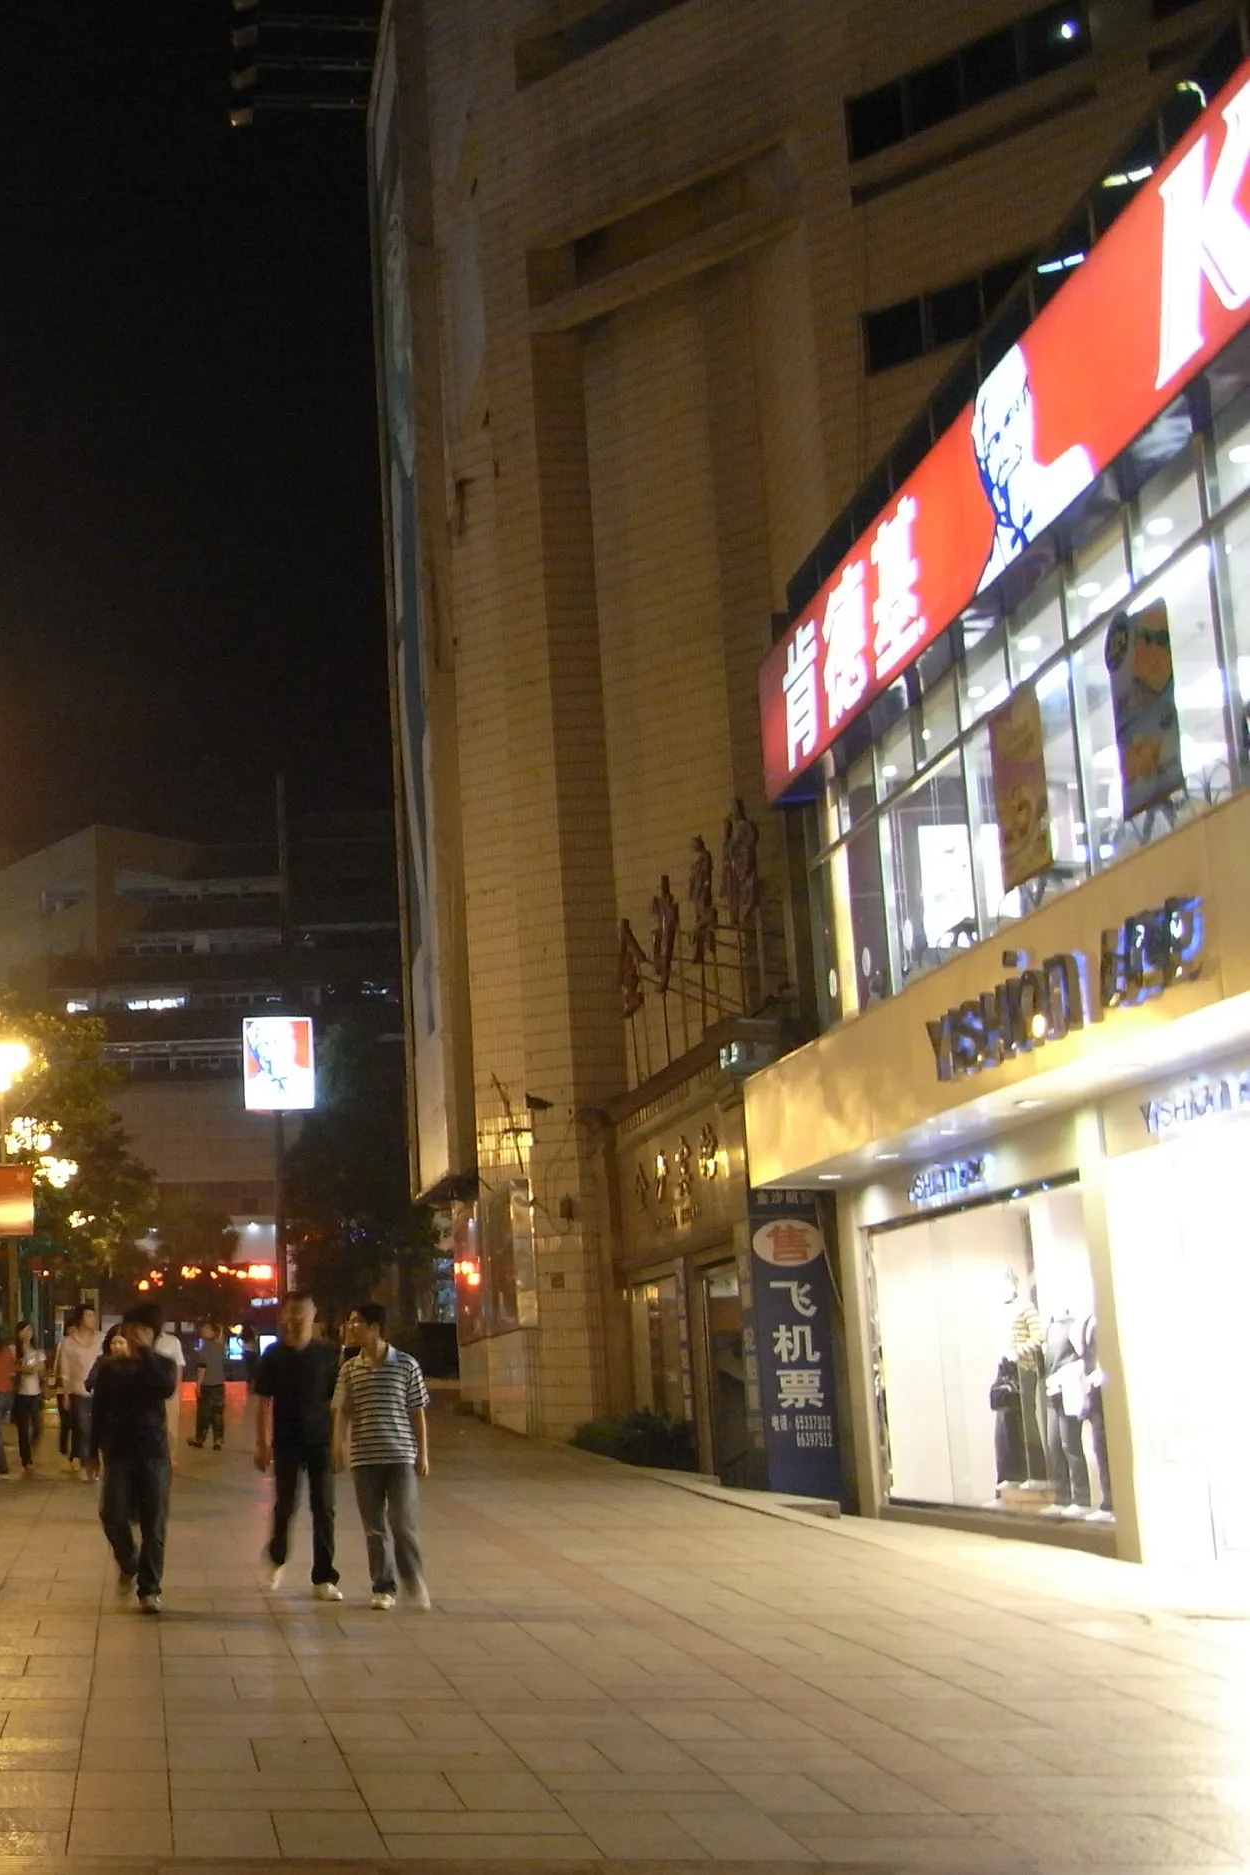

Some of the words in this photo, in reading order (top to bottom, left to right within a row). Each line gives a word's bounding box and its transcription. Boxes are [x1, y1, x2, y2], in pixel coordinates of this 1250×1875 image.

[783, 496, 925, 772] 肯德基
[769, 1280, 824, 1408] 飞机票
